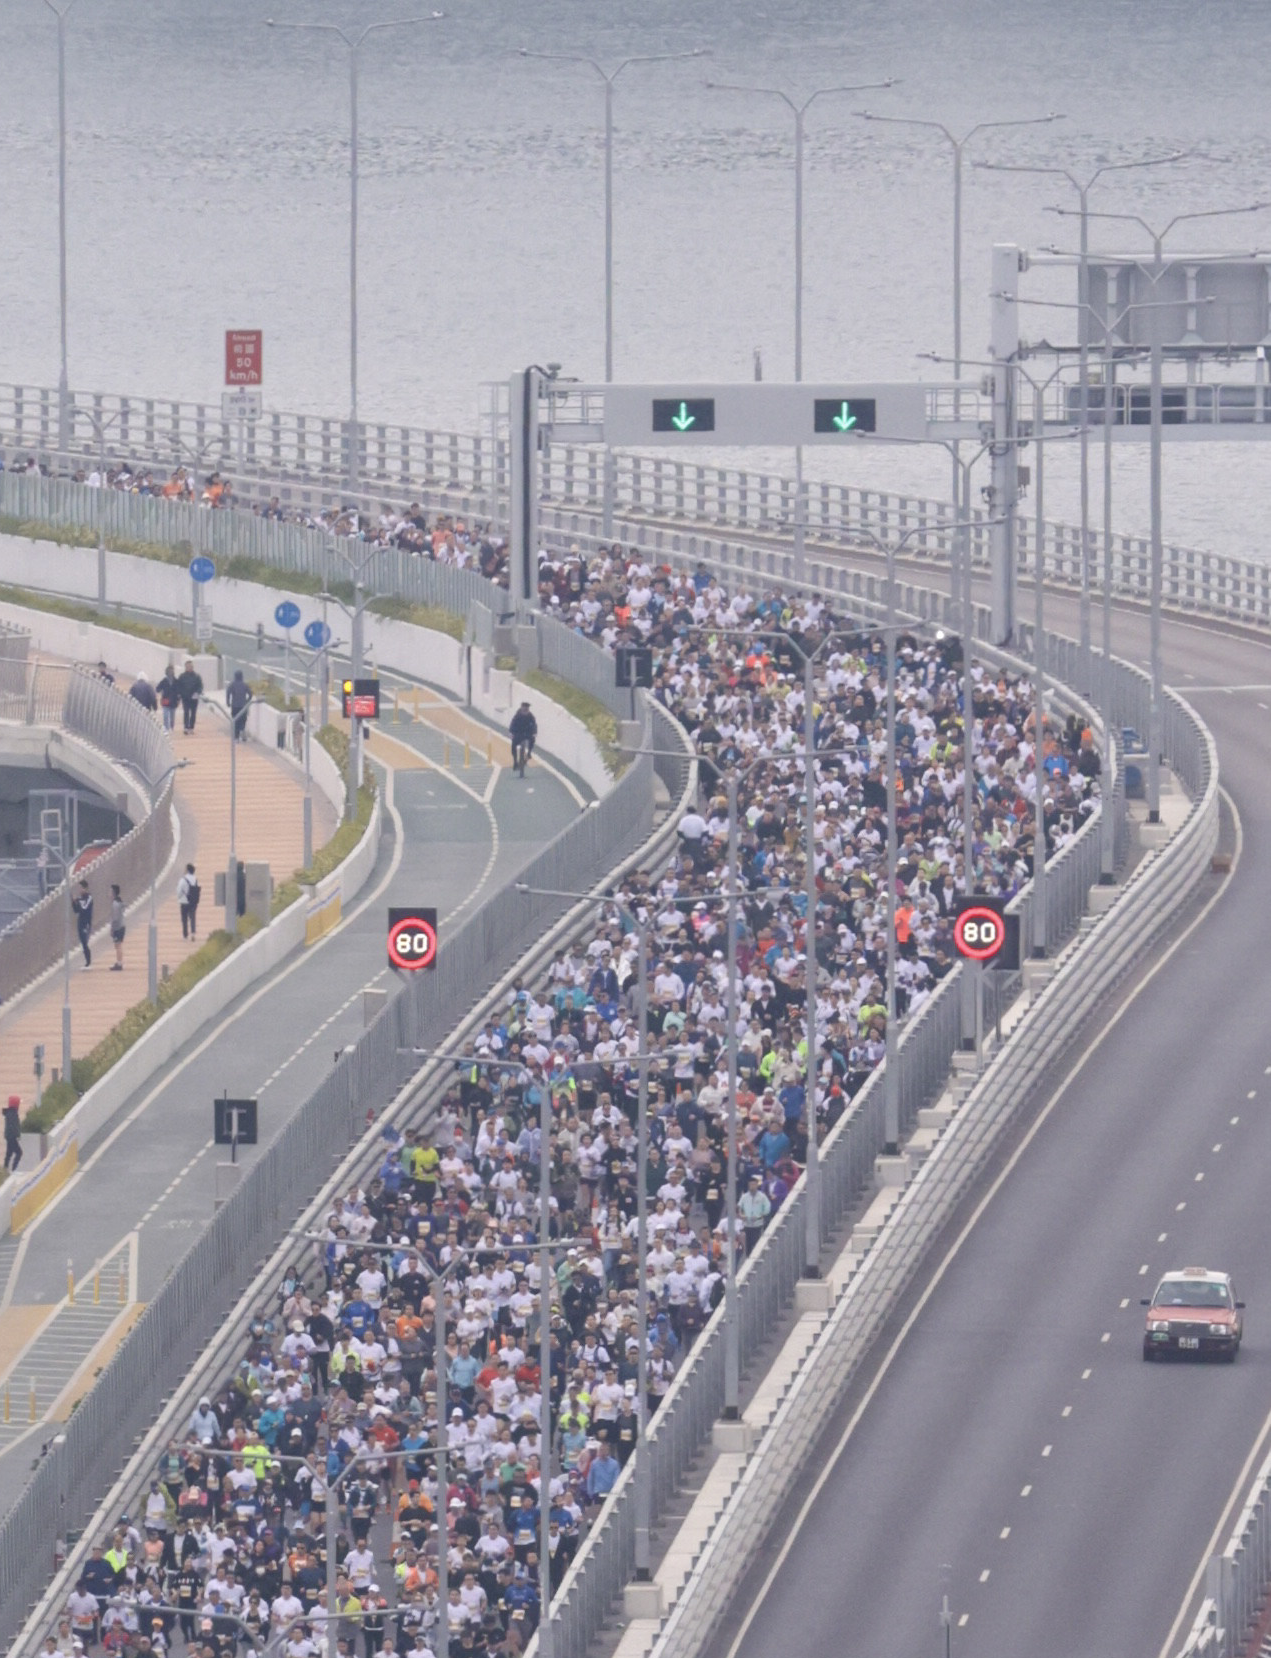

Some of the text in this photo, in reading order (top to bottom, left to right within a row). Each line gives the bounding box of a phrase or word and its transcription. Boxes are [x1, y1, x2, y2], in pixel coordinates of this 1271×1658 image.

[236, 357, 252, 368] 50
[229, 369, 258, 381] km/h
[964, 922, 996, 943] 80
[396, 933, 428, 954] 80
